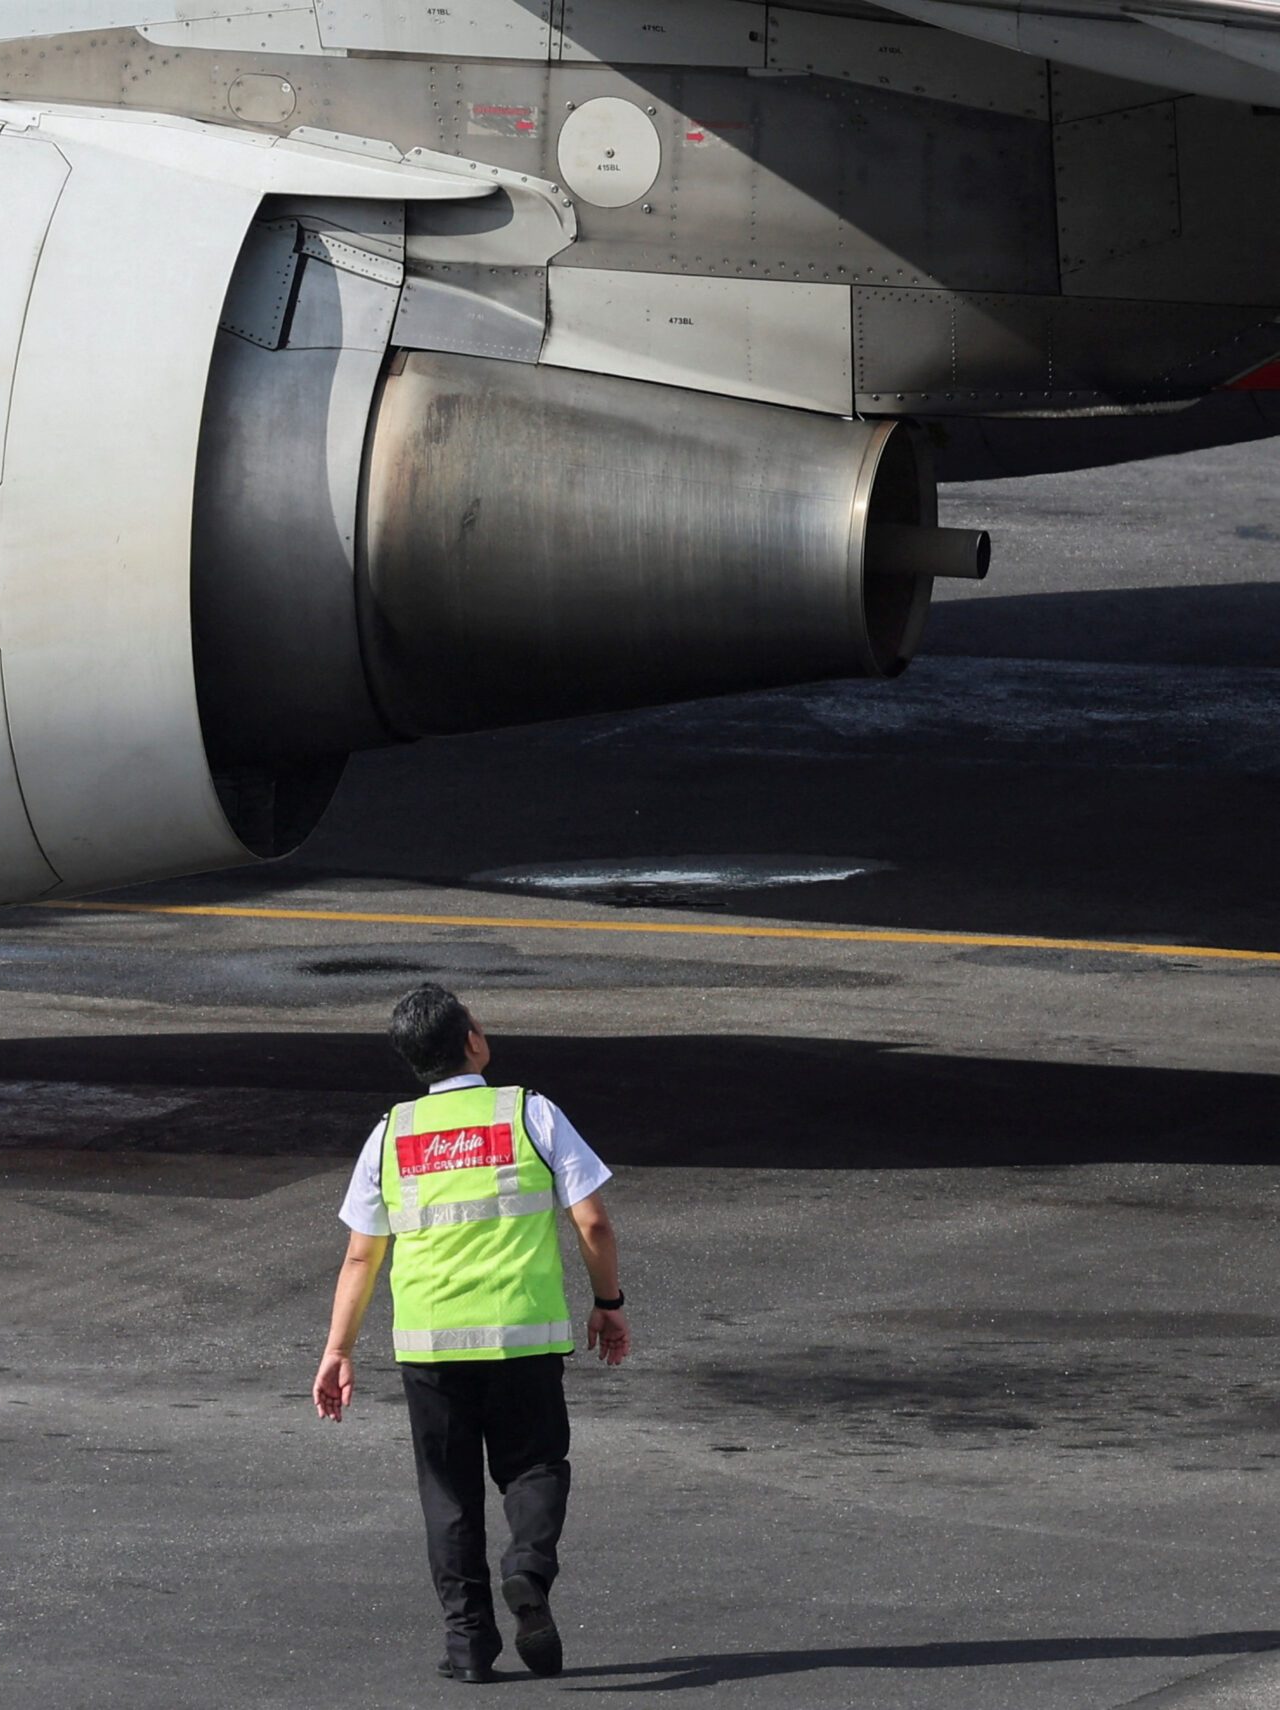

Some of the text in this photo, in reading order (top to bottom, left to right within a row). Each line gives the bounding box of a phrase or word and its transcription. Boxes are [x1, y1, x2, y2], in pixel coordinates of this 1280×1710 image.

[427, 8, 451, 16] 471BL
[669, 317, 695, 325] 473BL
[401, 1163, 431, 1175] FLIGHT
[485, 1154, 511, 1165] ONLY
